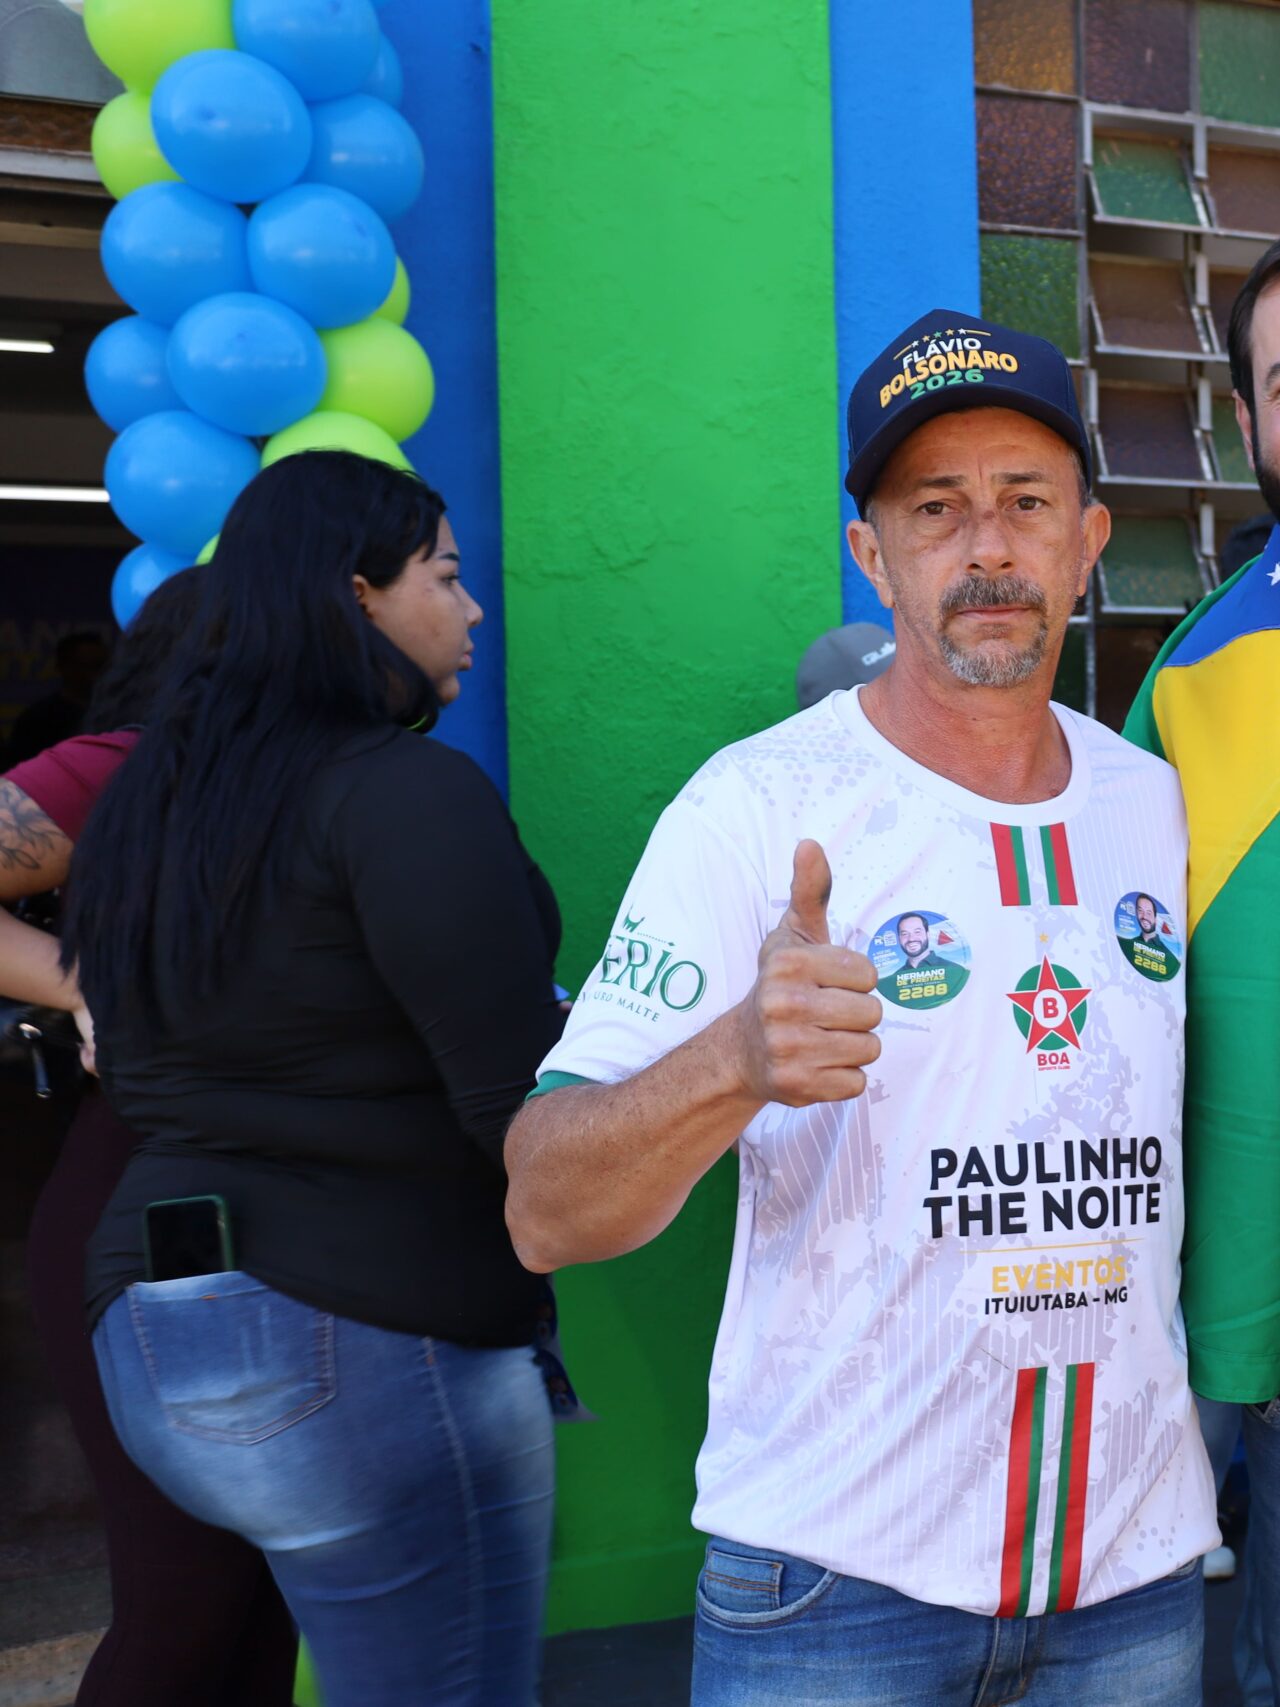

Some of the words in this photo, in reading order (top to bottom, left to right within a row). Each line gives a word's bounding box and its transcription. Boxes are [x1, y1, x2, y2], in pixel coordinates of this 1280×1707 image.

[902, 337, 982, 369] FLÁVIO
[879, 349, 1019, 408] BOLSONARO
[909, 368, 985, 400] 2026
[599, 934, 707, 1013] ERIO
[896, 968, 945, 981] HERMANO
[1134, 954, 1167, 975] 2288
[898, 983, 948, 1001] 2288
[616, 997, 660, 1022] MALTE
[1042, 997, 1060, 1019] B
[1037, 1052, 1070, 1066] BOA
[930, 1136, 1162, 1190] PAULINHO
[922, 1191, 1028, 1239] THE
[1042, 1182, 1161, 1232] NOITE
[991, 1255, 1127, 1293] EVENTOS
[984, 1291, 1089, 1315] ITUIUTABA
[1104, 1286, 1129, 1305] MG
